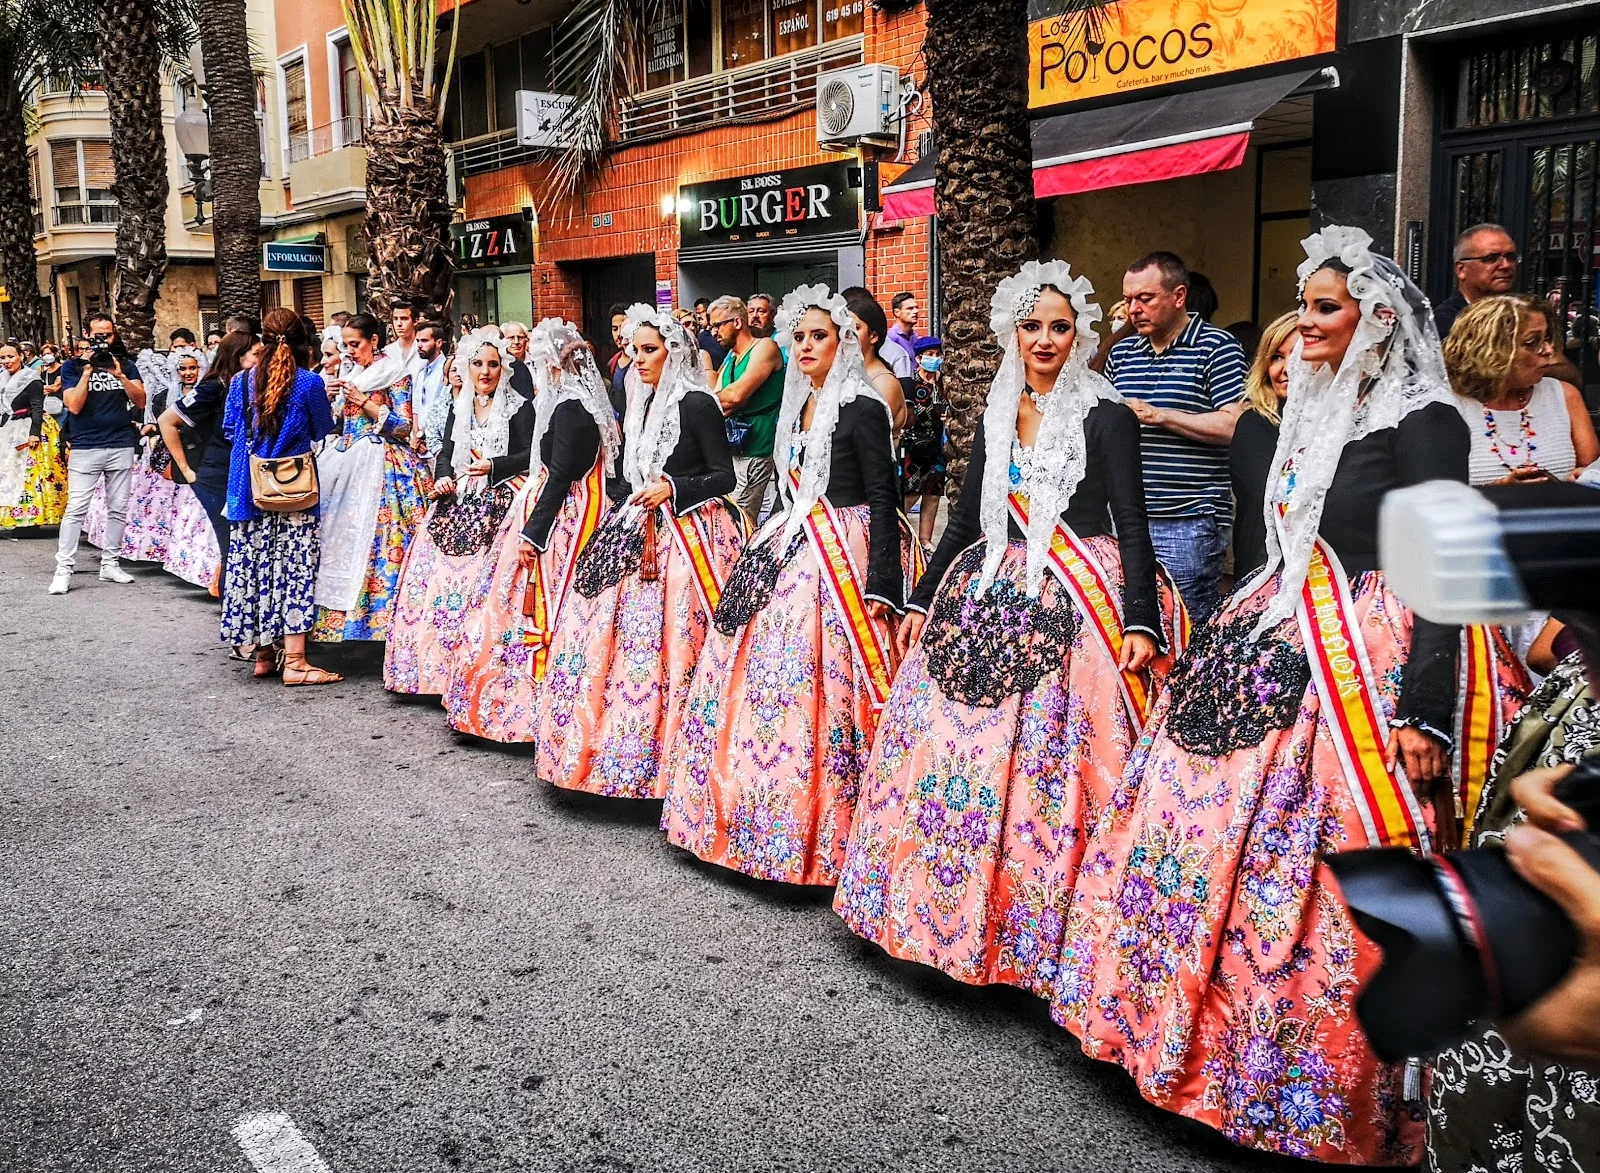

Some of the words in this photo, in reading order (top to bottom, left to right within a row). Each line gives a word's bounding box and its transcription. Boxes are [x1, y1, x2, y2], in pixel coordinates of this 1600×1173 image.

[826, 8, 839, 22] 619
[841, 4, 851, 17] 45
[778, 13, 810, 36] ESPAÑOL
[1040, 20, 1070, 39] LOS
[653, 28, 676, 45] PILATES
[653, 41, 676, 59] LATINOS
[1116, 75, 1150, 89] Cafetería,
[1152, 74, 1163, 83] bar
[1164, 73, 1169, 81] y
[1169, 67, 1194, 79] mucho
[1195, 64, 1211, 74] más
[741, 179, 754, 191] EL
[754, 174, 782, 188] BOSS
[699, 183, 832, 232] BURGER
[459, 228, 517, 260] IZZA
[268, 252, 323, 264] INFORMACION
[90, 372, 117, 382] ACK
